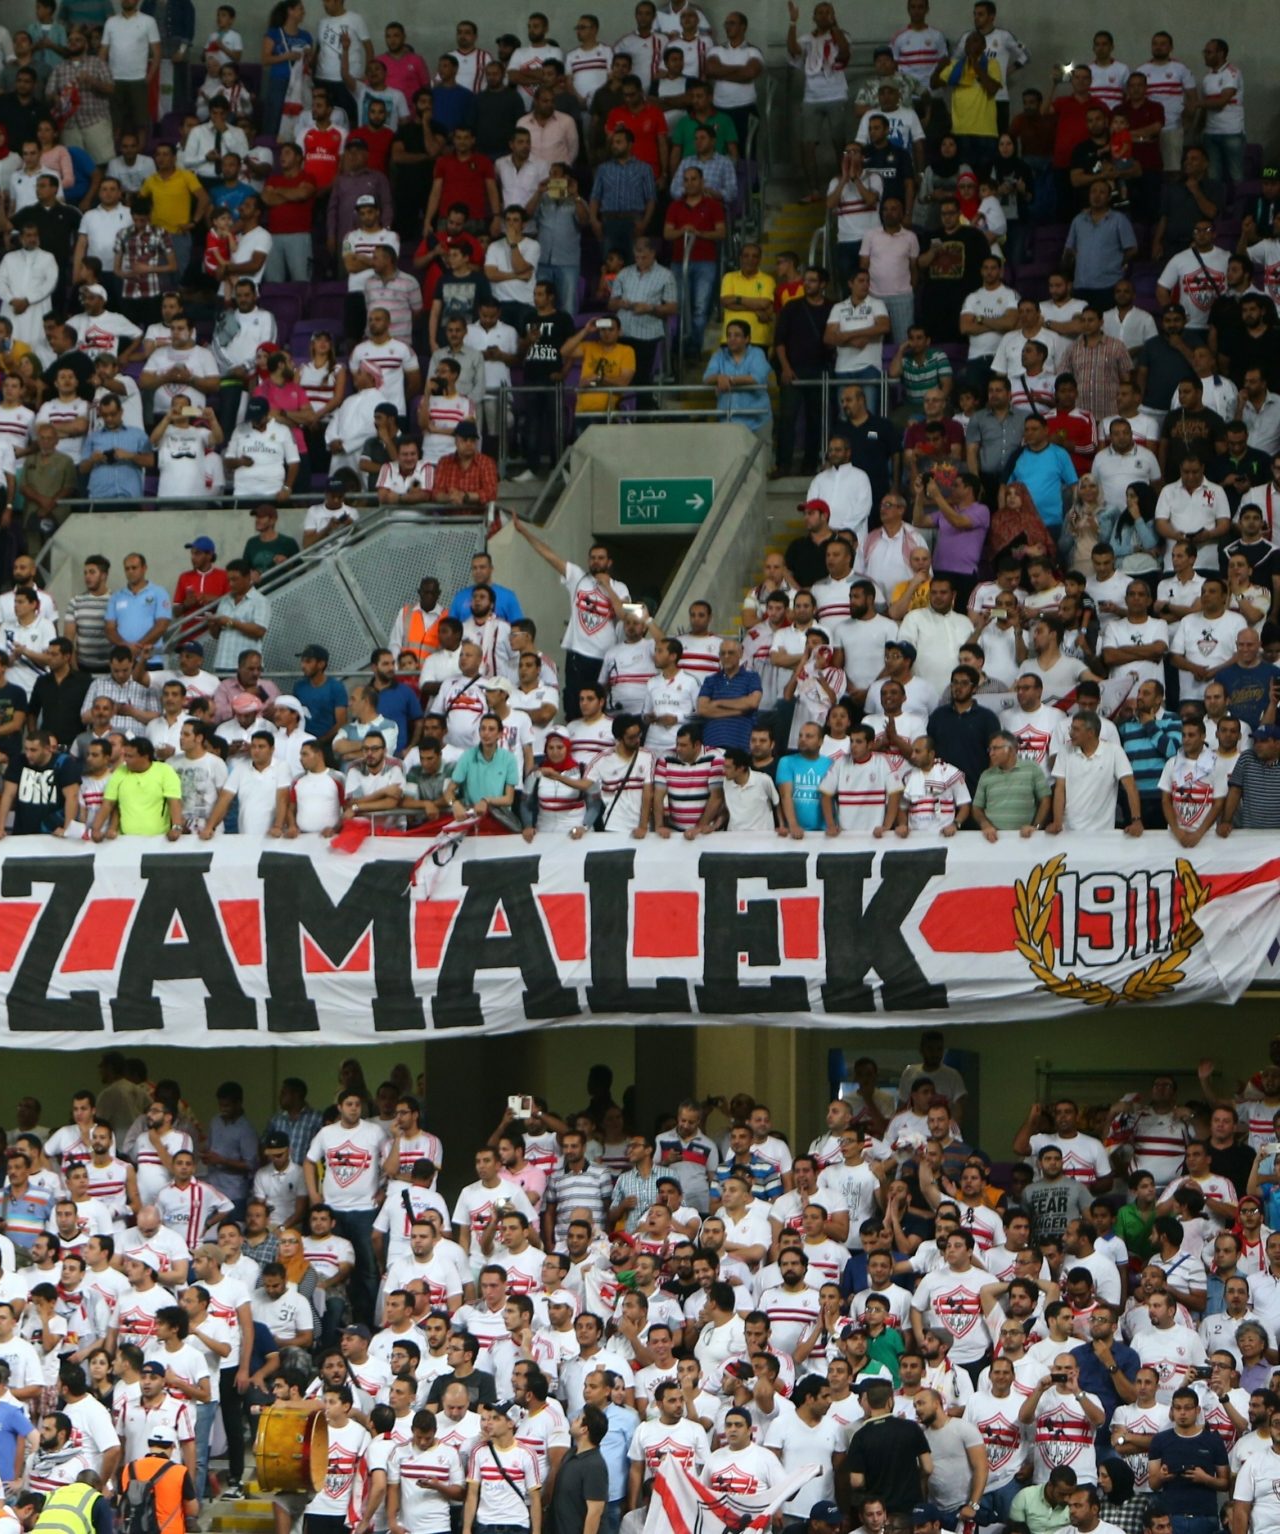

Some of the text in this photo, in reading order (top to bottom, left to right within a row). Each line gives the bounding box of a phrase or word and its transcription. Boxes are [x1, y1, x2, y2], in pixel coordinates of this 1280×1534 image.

[626, 487, 667, 505] مخرج
[626, 505, 660, 519] EXIT
[1056, 870, 1175, 968] 1911
[2, 848, 947, 1032] ZAMALEK
[1032, 1196, 1067, 1213] FEAR
[1213, 1324, 1222, 1335] 2
